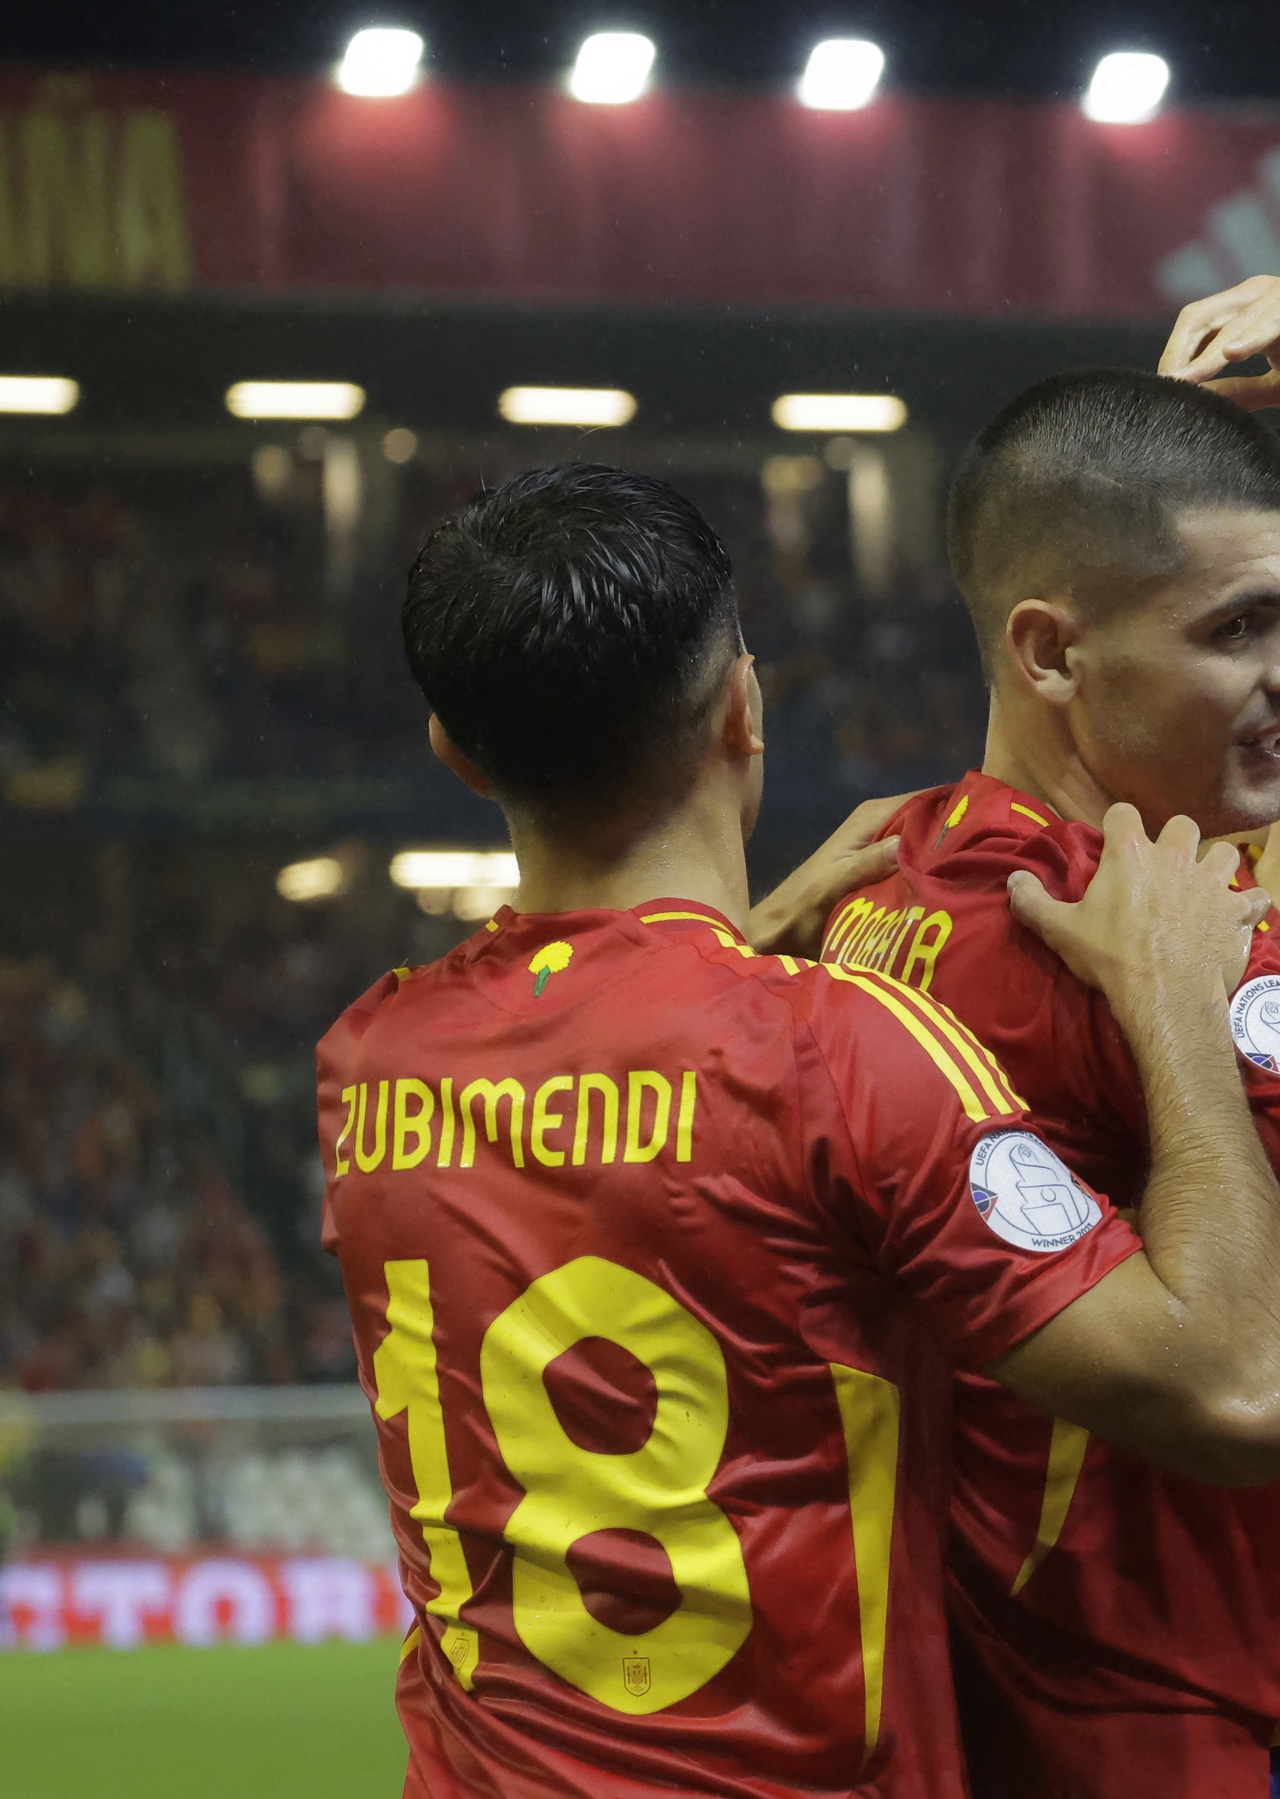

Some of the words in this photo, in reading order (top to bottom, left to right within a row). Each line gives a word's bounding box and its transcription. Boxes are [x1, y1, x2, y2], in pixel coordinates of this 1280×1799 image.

[820, 897, 953, 992] MORATA
[1236, 983, 1264, 1019] NATIONS
[1234, 1017, 1246, 1039] UEFA
[335, 1071, 697, 1178] ZUBIMENDI
[975, 1143, 993, 1166] UEFA
[1031, 1234, 1077, 1248] WINNER
[373, 1255, 753, 1716] 18
